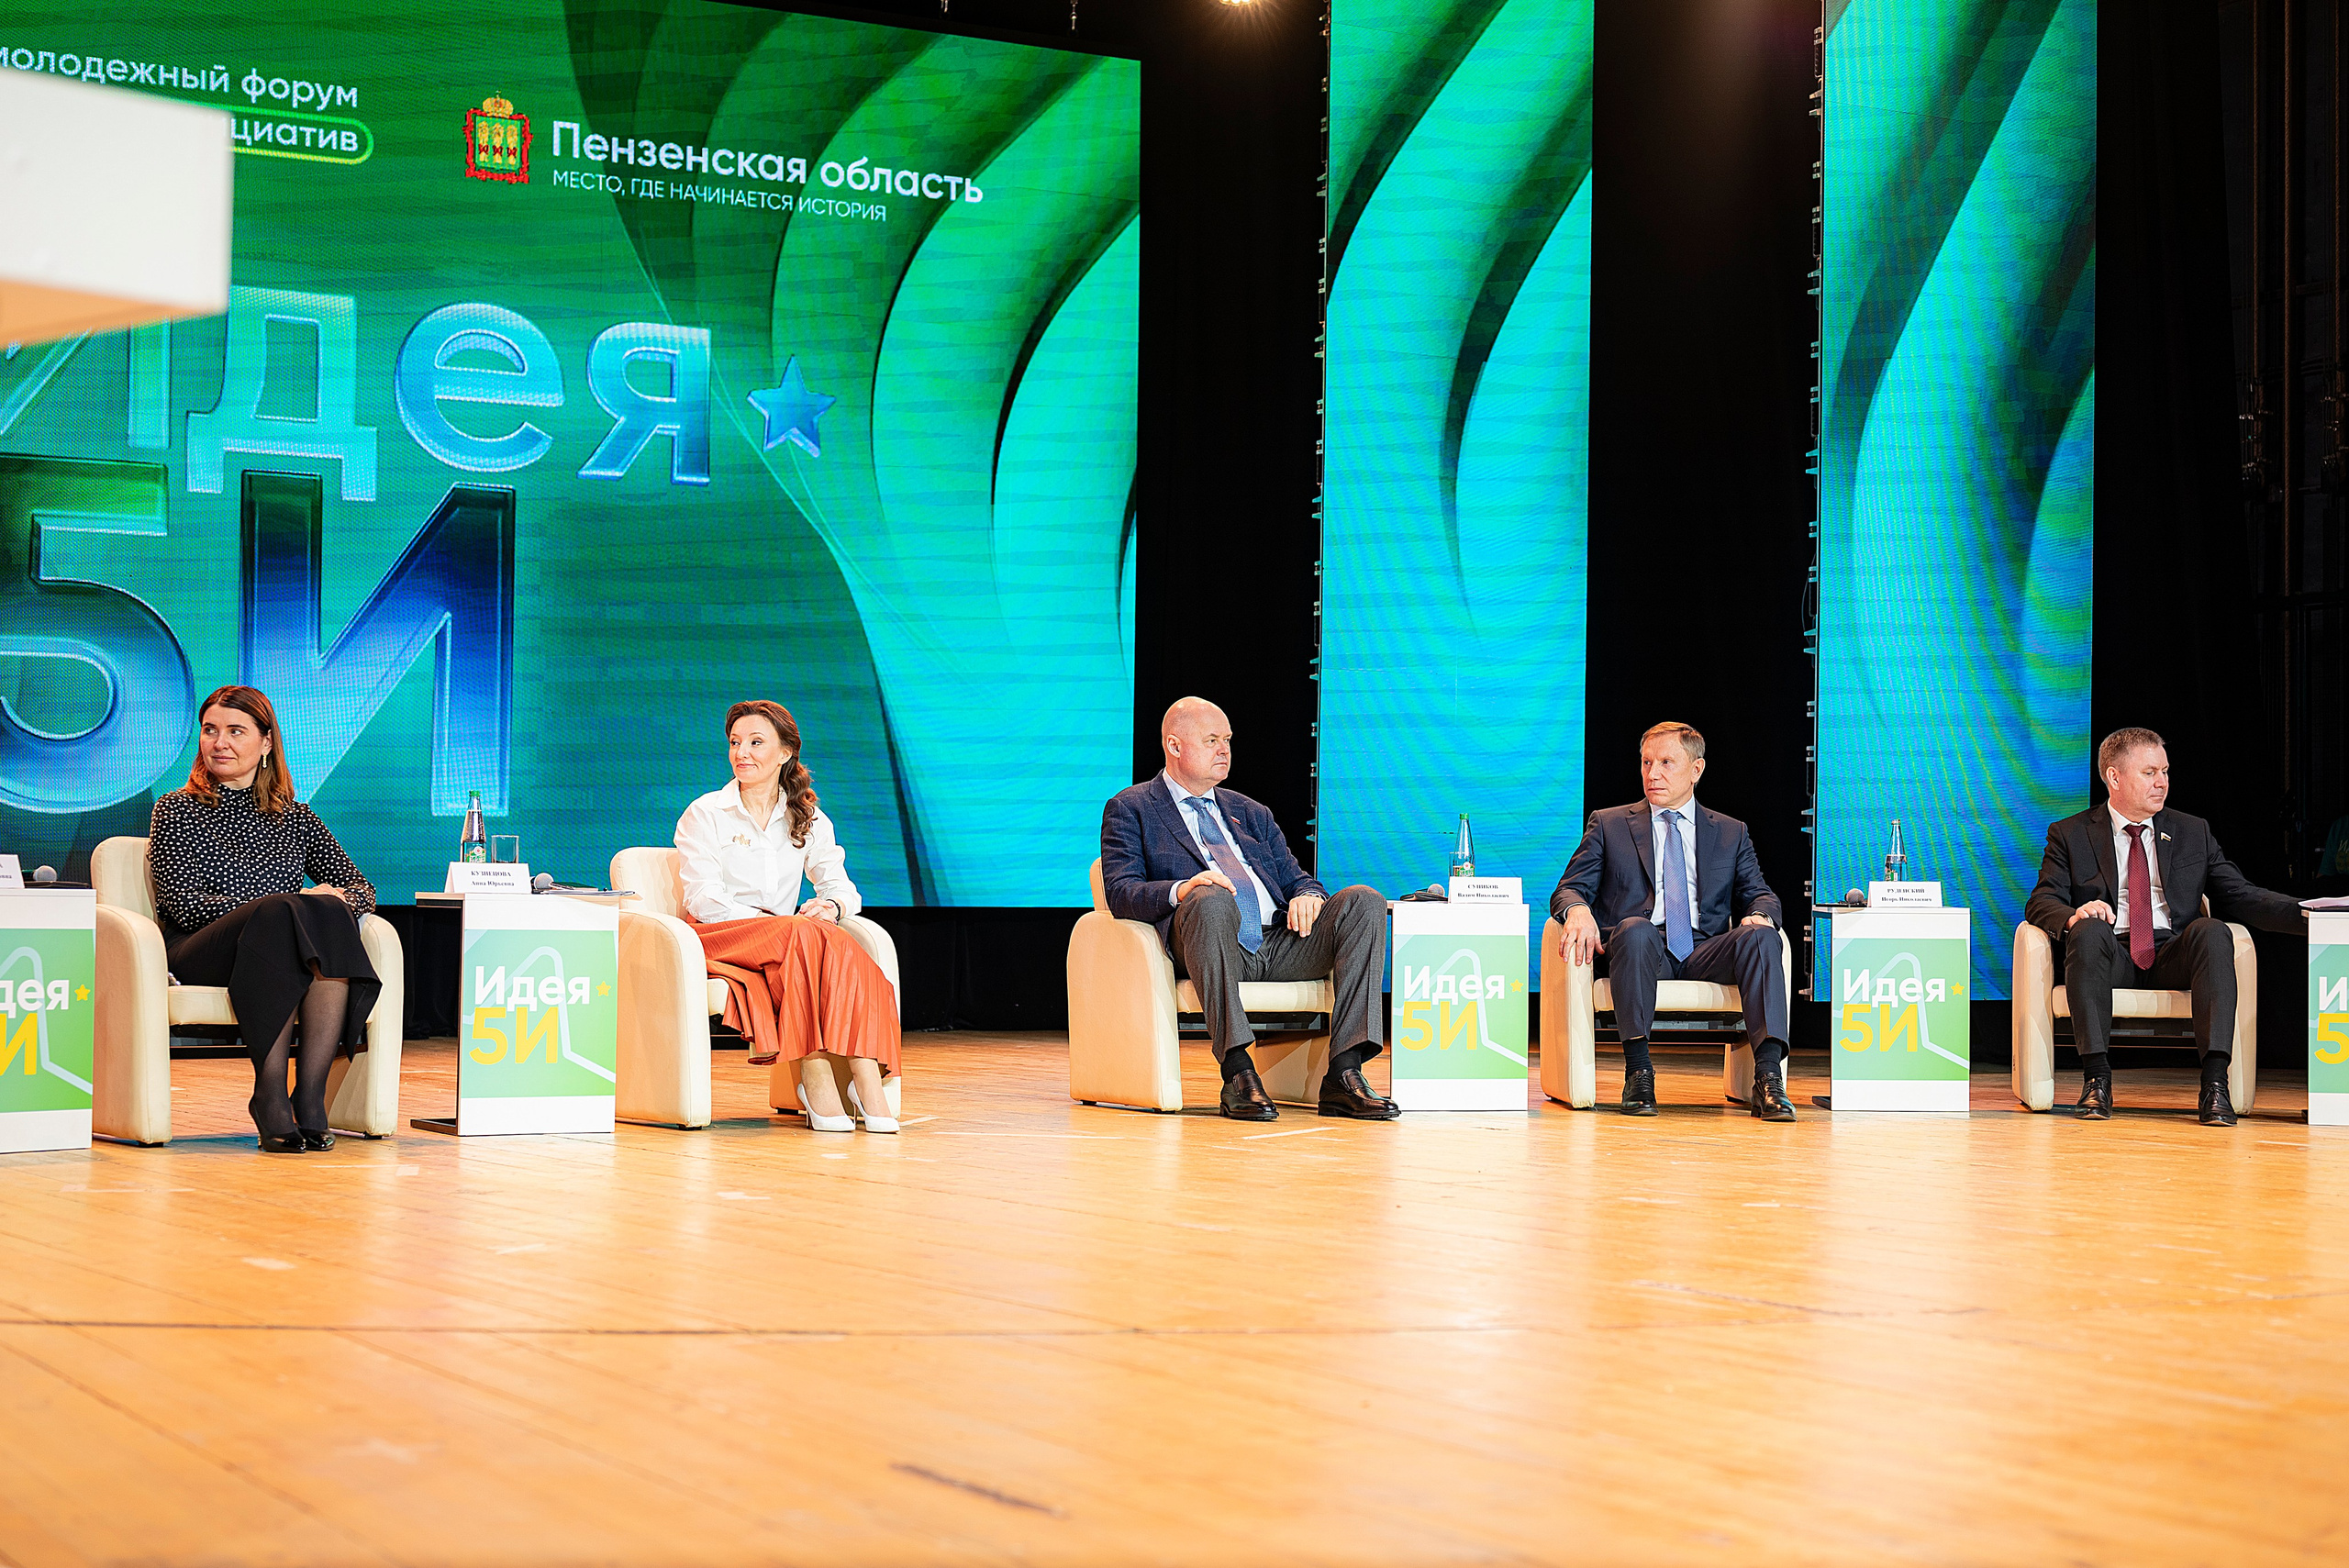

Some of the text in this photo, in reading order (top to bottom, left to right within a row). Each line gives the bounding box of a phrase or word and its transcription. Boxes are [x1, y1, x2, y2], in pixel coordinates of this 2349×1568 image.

[241, 67, 358, 111] форум
[230, 117, 359, 151] циатив
[552, 120, 984, 203] Пензенская область
[553, 169, 887, 222] МЕСТО, ГДЕ НАЧИНАЕТСЯ ИСТОРИЯ
[474, 965, 591, 1012] Идея
[1403, 965, 1505, 1006] Идея
[1842, 968, 1946, 1008] Идея
[469, 1006, 559, 1065] 5И
[1399, 1001, 1477, 1051] 5И
[1839, 1004, 1919, 1053] 5И
